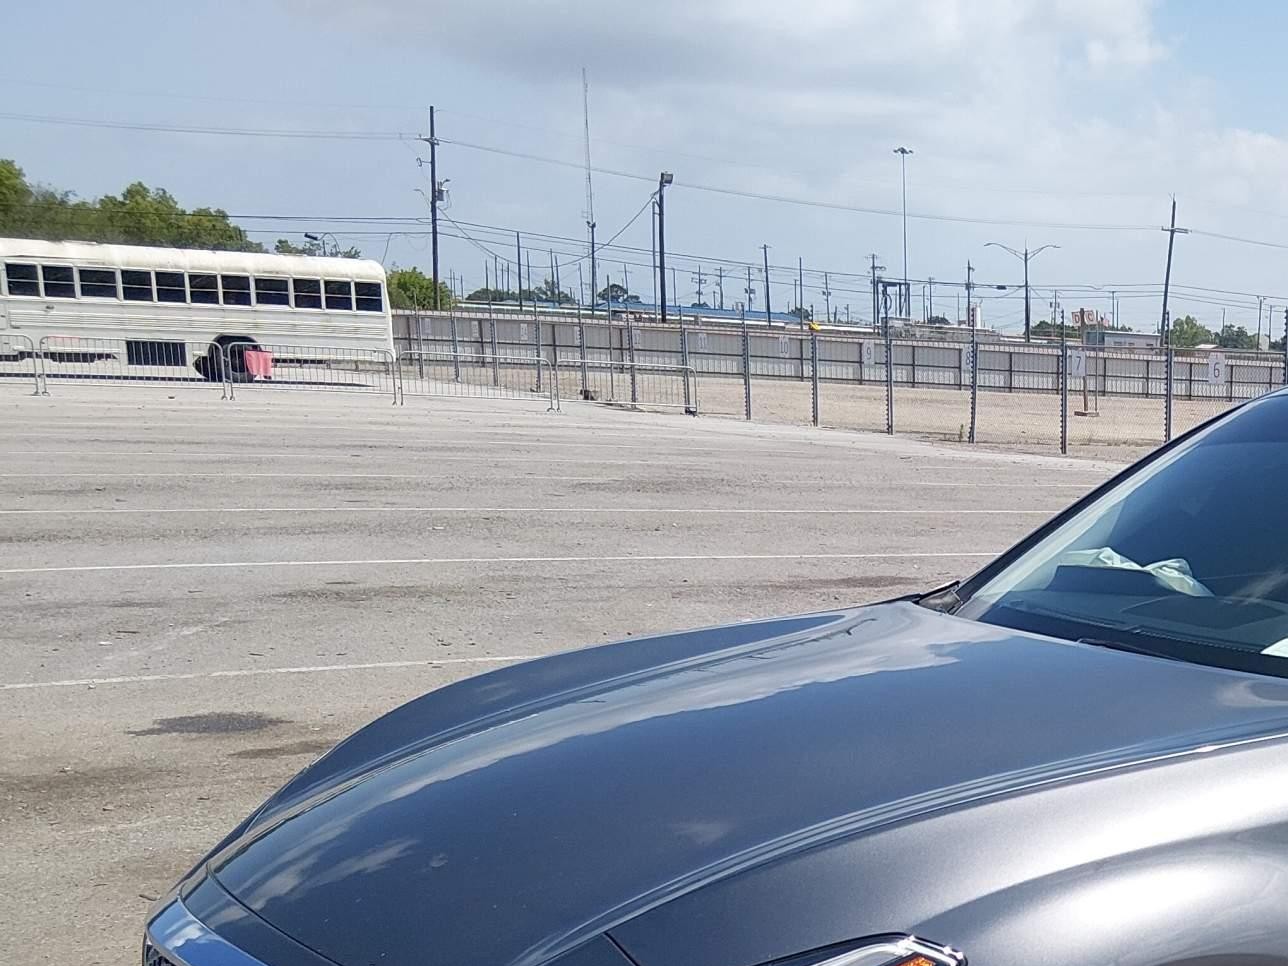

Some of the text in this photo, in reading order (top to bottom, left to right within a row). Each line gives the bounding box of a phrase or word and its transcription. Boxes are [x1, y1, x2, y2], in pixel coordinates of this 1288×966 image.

[866, 346, 872, 360] 9
[1075, 355, 1082, 370] 7
[1213, 361, 1220, 379] 6
